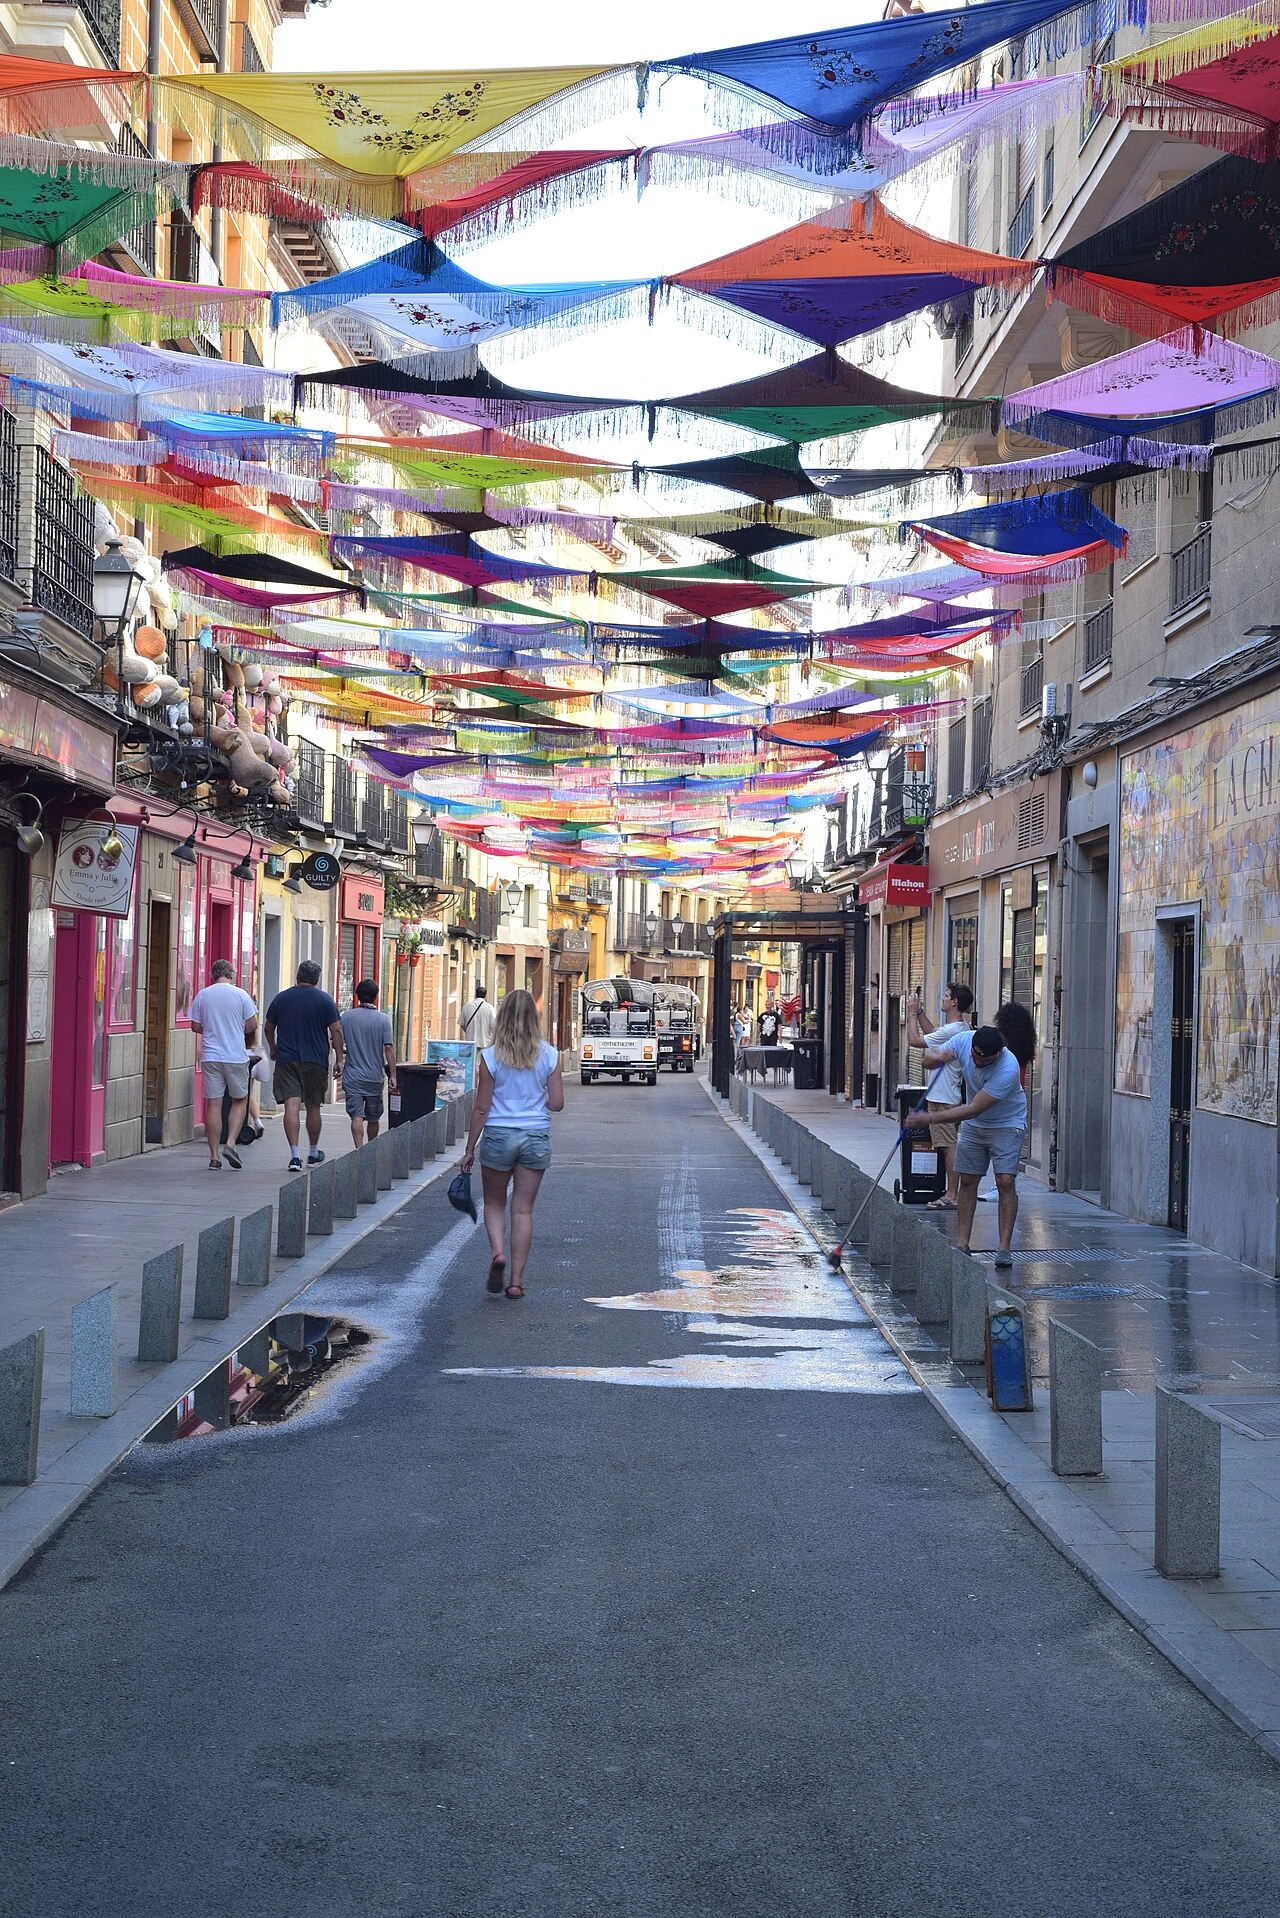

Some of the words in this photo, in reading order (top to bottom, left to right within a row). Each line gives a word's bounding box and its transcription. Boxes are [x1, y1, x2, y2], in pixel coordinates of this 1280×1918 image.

[1243, 735, 1280, 812] CH
[69, 869, 93, 879] Emma
[305, 873, 336, 882] GUILTY
[891, 878, 925, 888] Mahou
[76, 892, 93, 903] Desde
